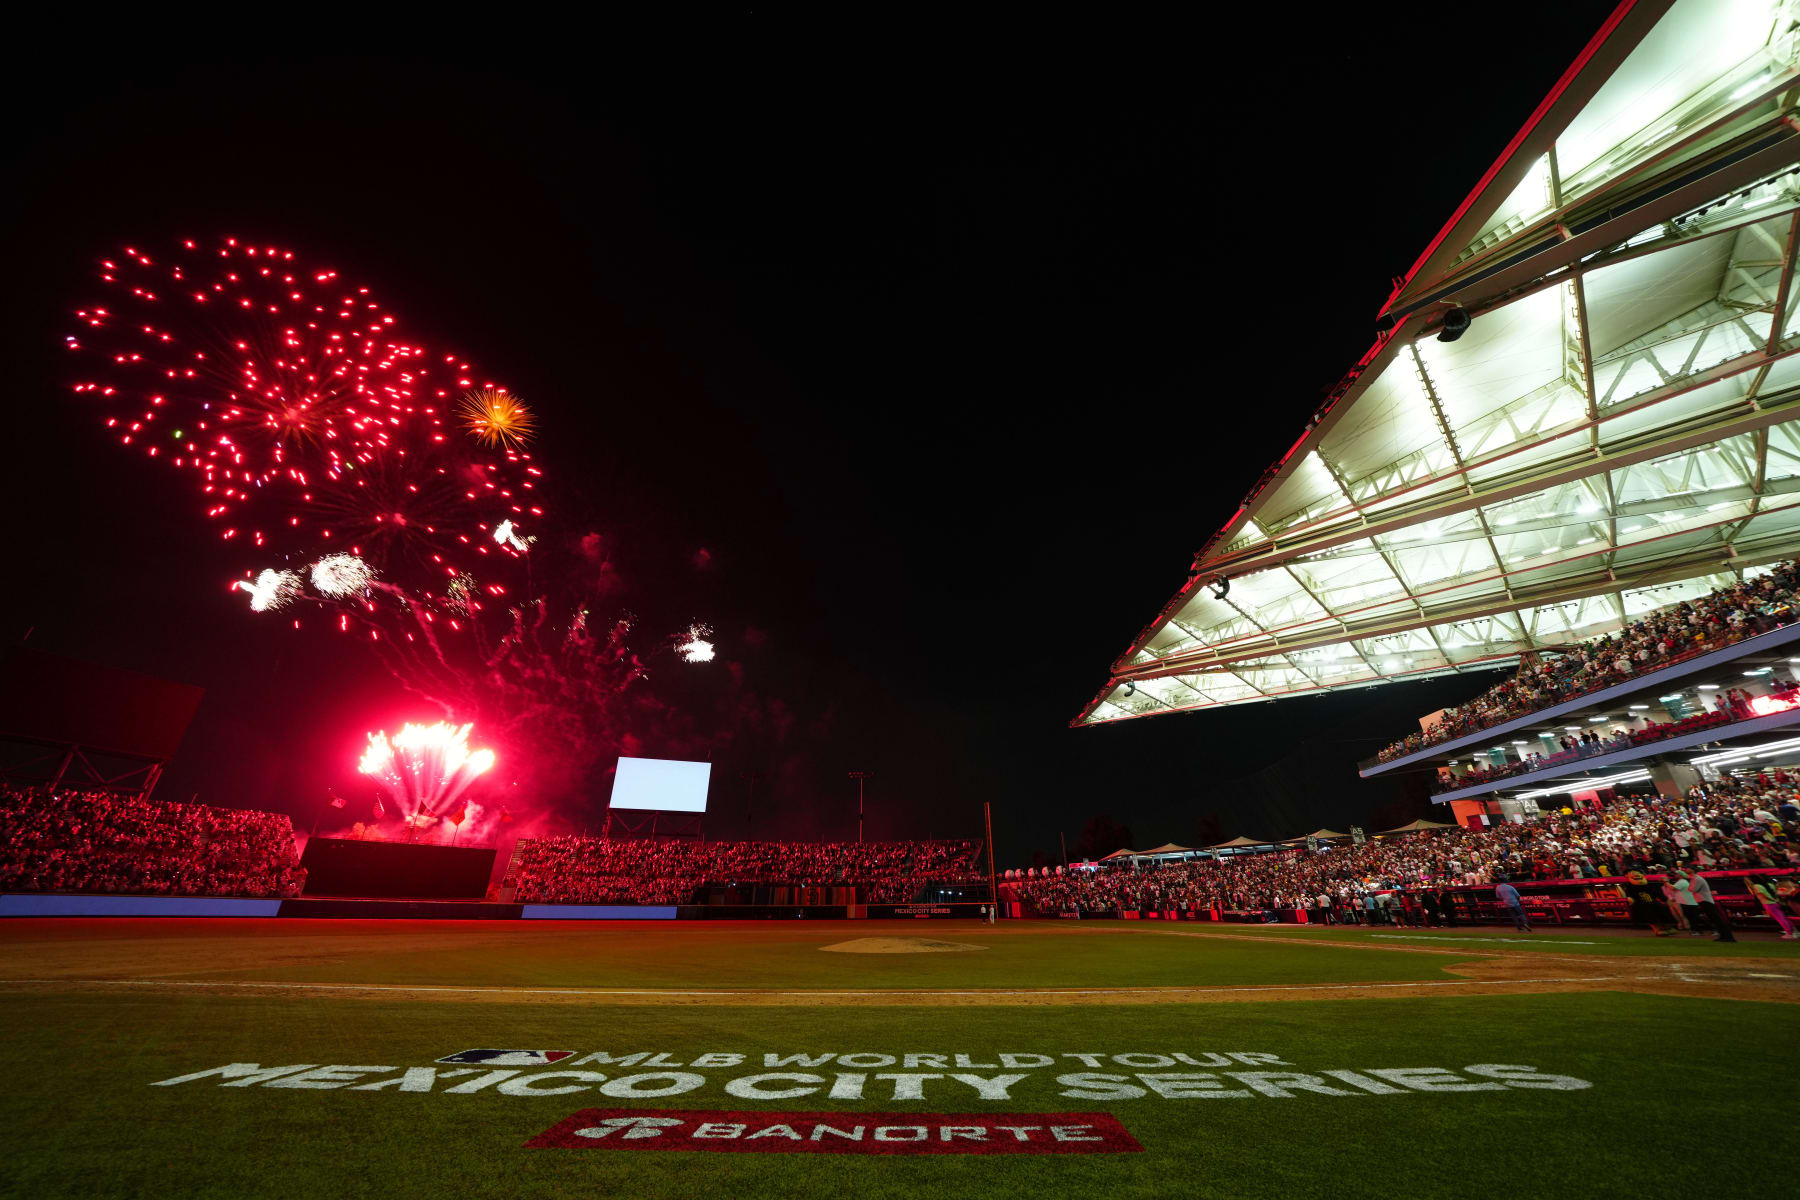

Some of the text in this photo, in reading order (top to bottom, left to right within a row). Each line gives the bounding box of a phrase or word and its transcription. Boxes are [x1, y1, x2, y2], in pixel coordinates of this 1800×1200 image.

[570, 1051, 1297, 1069] MLB WORLD TOUR
[149, 1062, 1594, 1101] MEXICO CITY SERIES
[691, 1122, 1104, 1142] BANORTE
